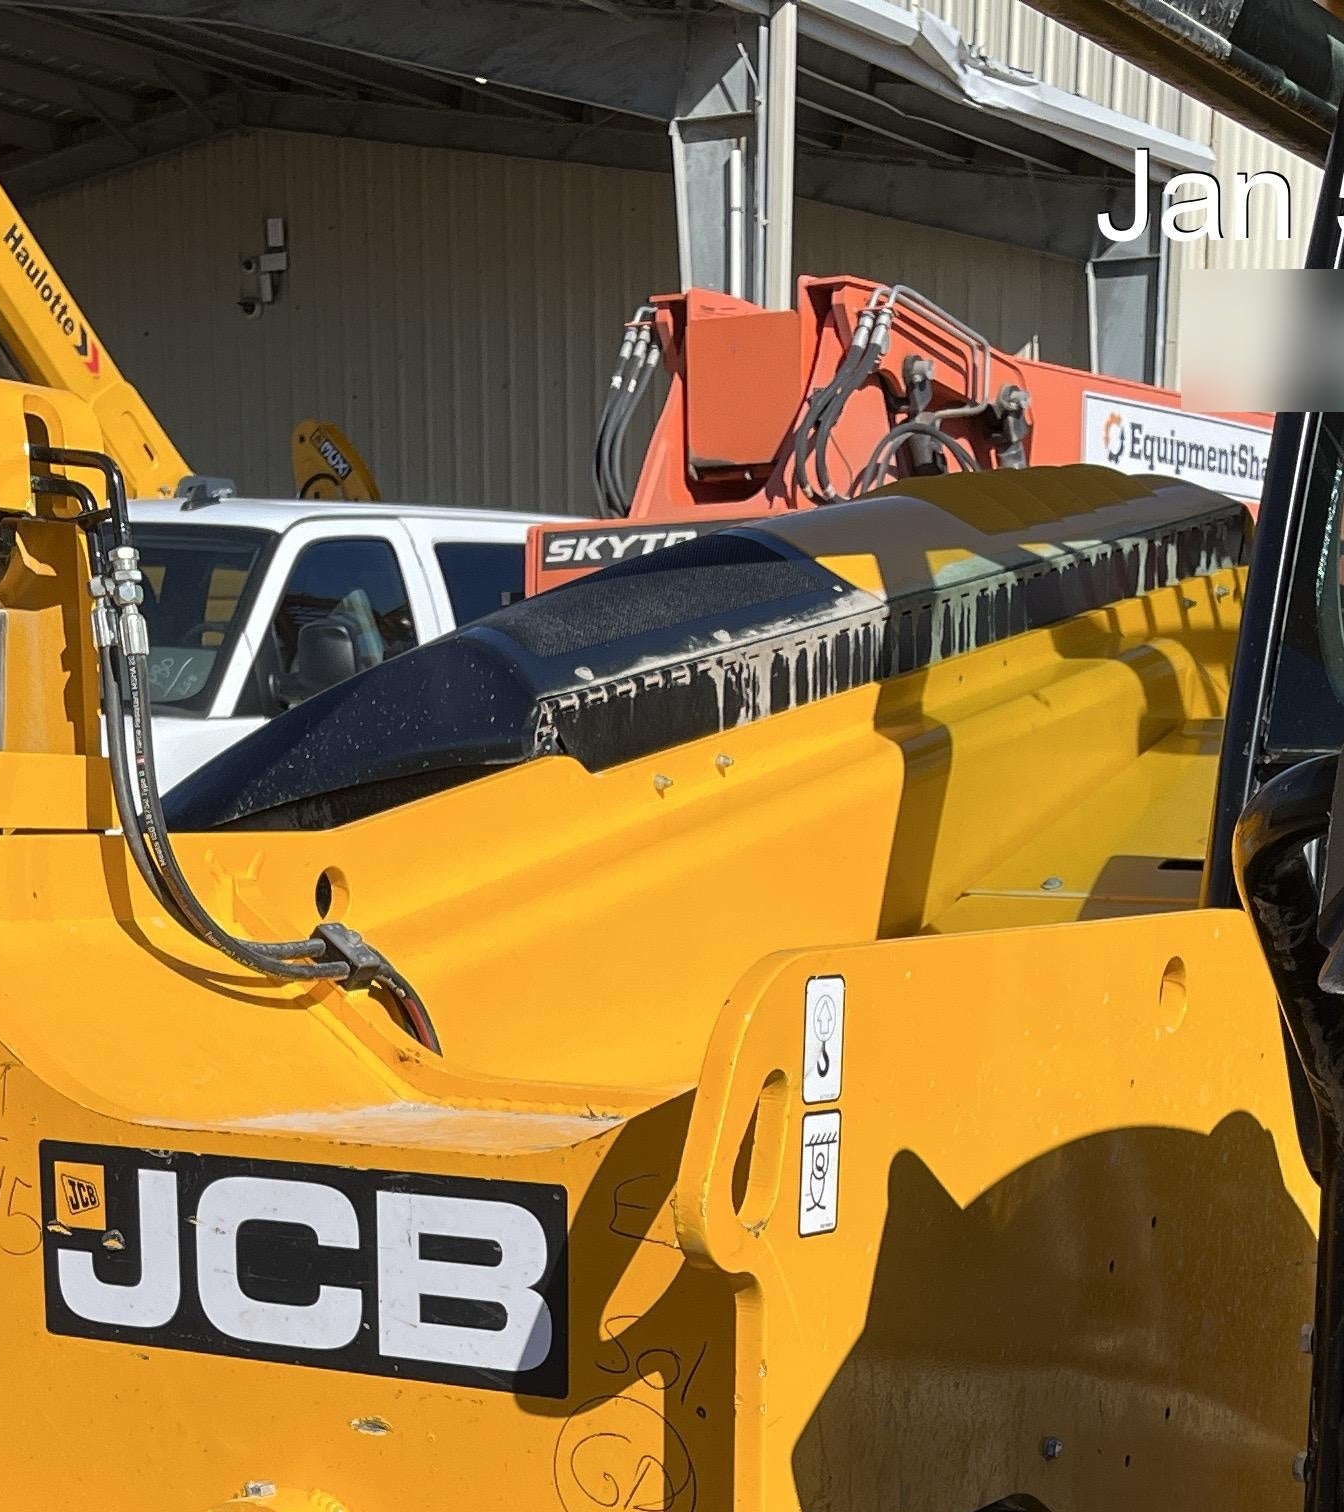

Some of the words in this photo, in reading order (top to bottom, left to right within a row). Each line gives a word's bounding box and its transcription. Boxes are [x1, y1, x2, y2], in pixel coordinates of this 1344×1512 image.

[2, 222, 75, 336] Haulotte
[66, 1179, 99, 1210] JCB
[57, 1168, 553, 1372] JCB
